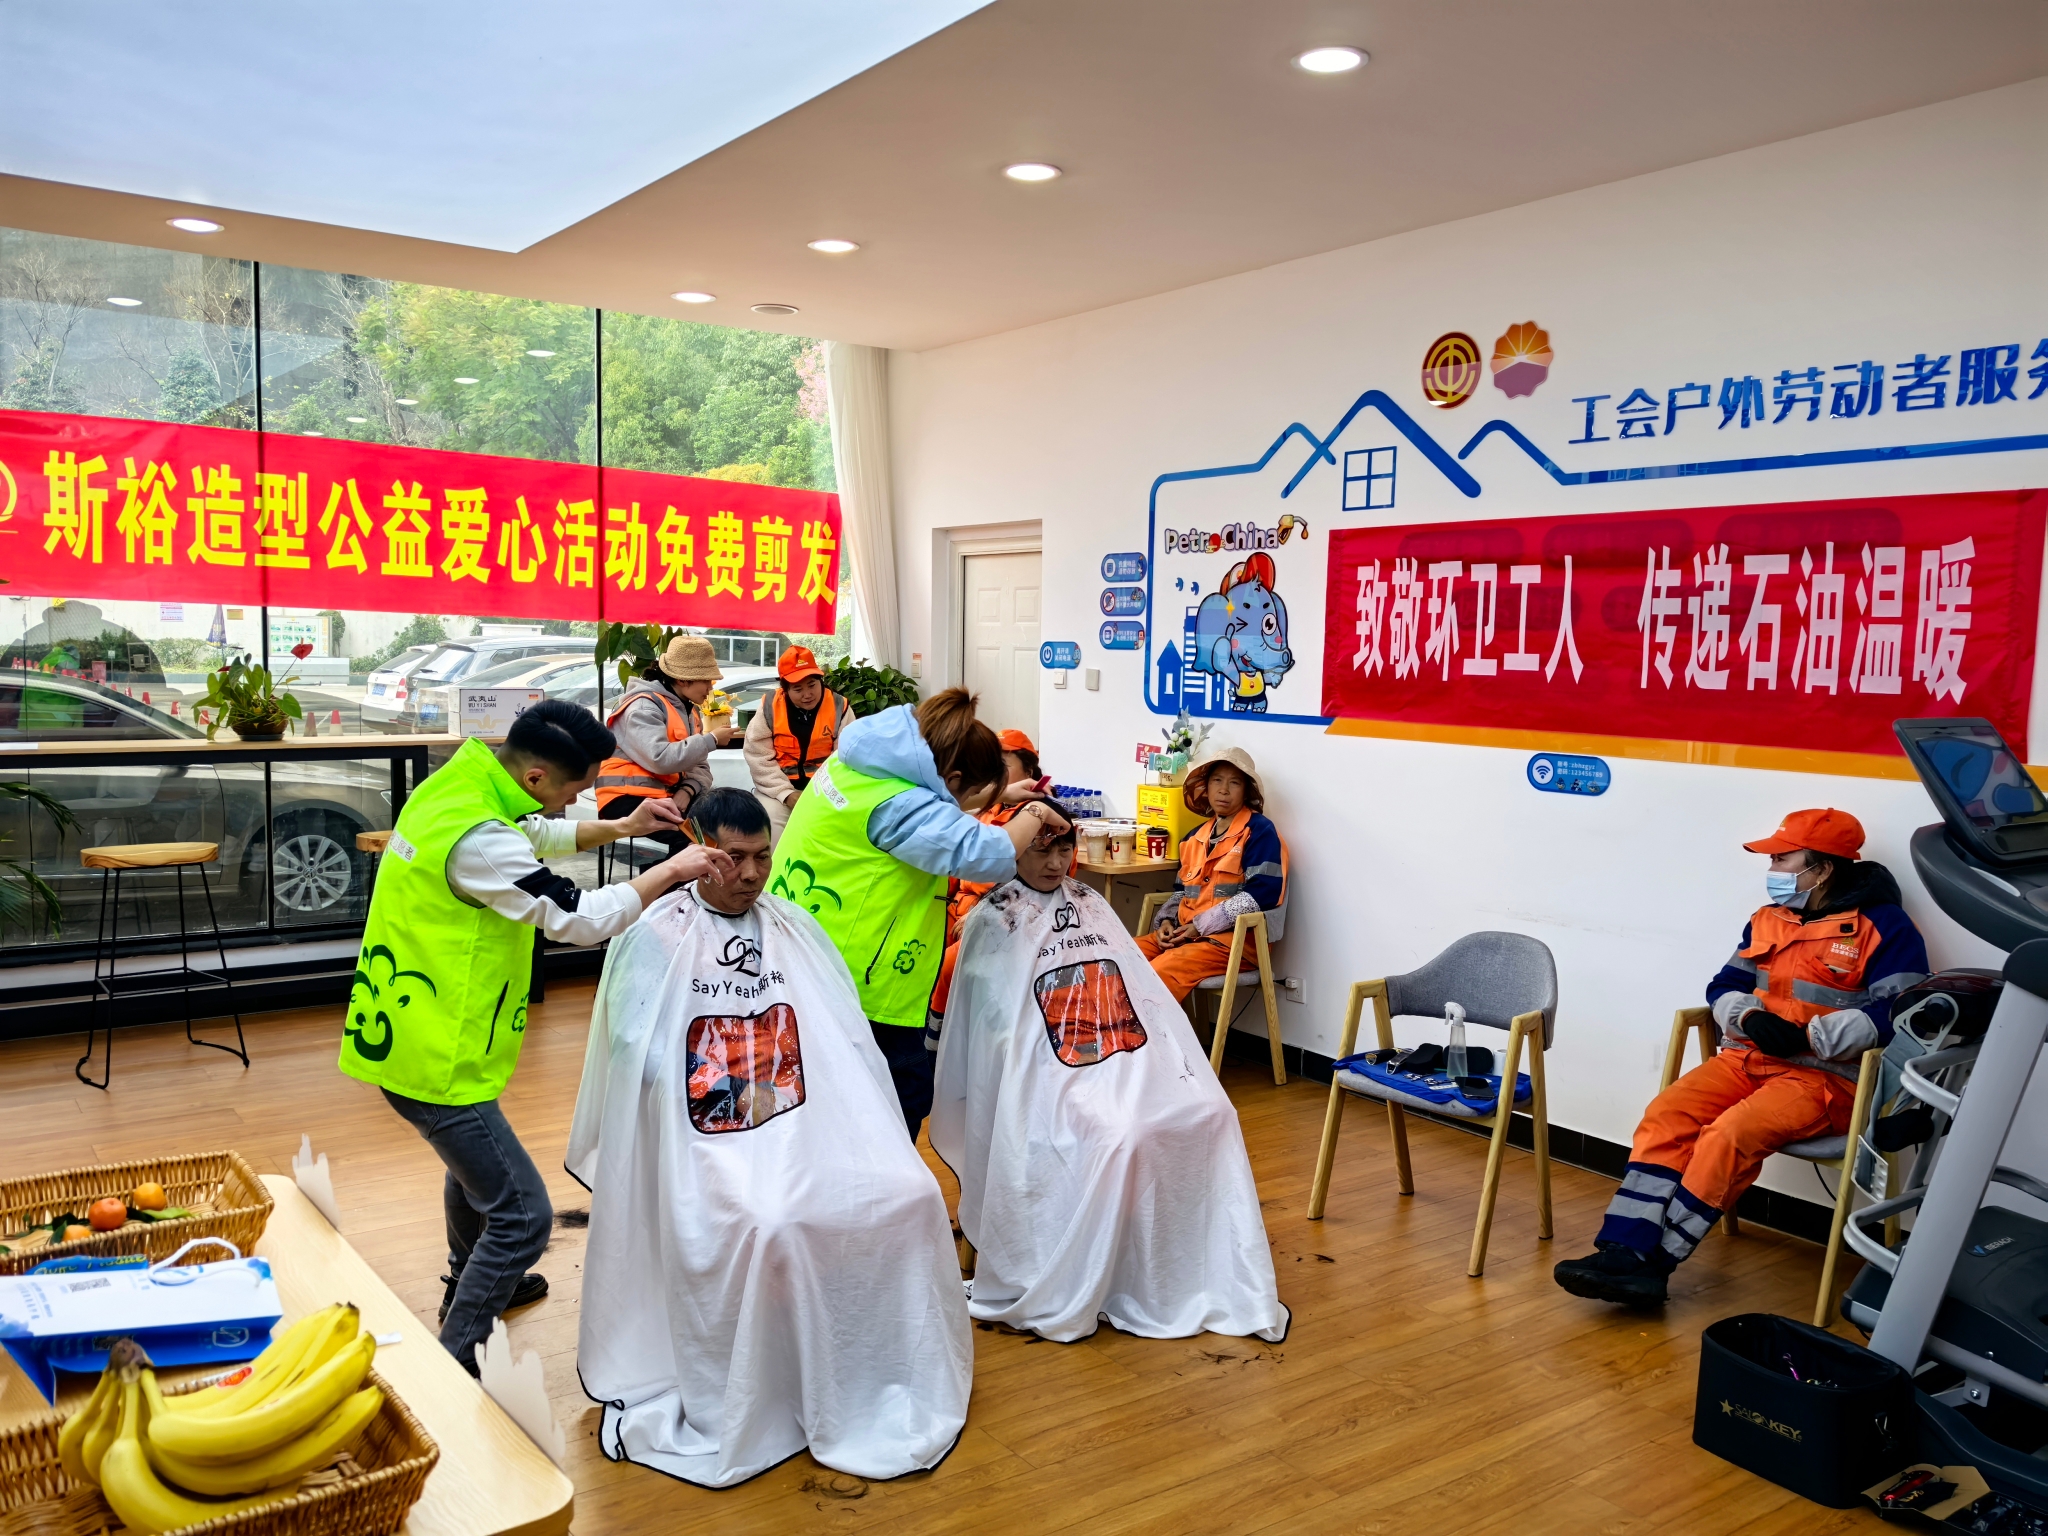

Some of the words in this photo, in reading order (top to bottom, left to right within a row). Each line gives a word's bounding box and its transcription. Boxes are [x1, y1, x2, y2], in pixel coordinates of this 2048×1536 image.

[43, 450, 836, 606] 斯裕造型公益爱心活动免费剪发
[1353, 555, 1584, 684] 致敬环卫工人
[1637, 536, 1976, 705] 传递石油温暖
